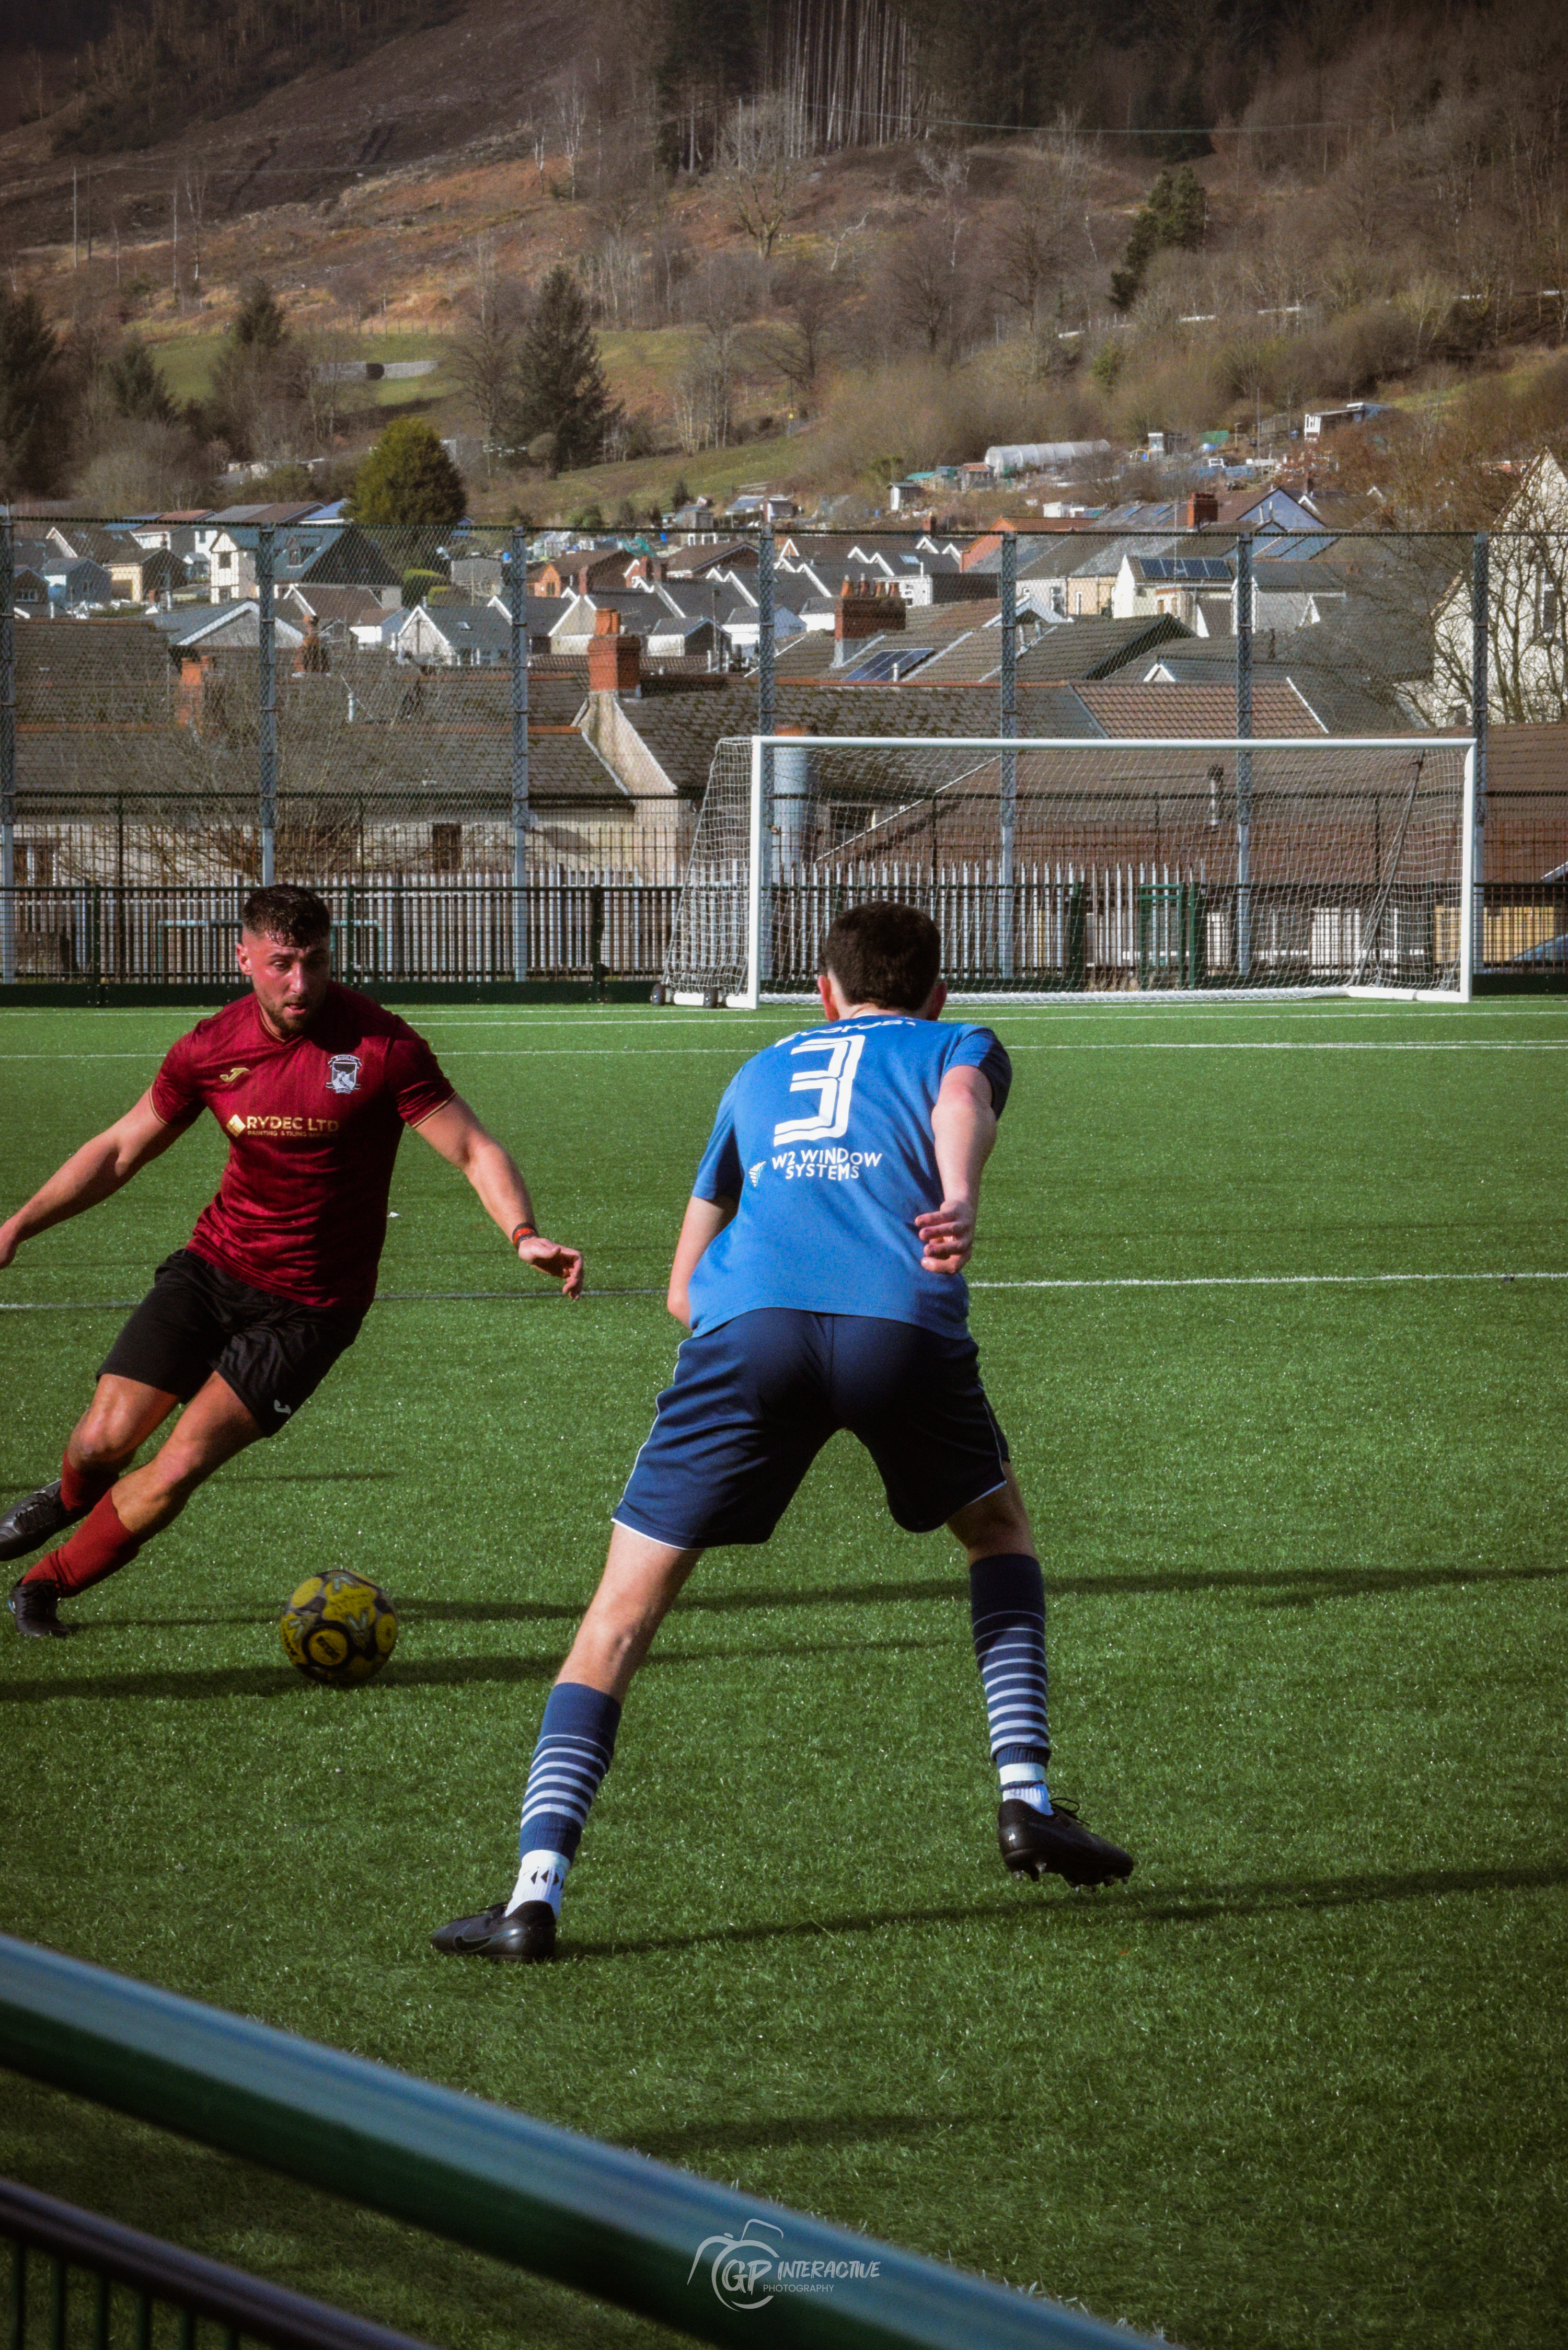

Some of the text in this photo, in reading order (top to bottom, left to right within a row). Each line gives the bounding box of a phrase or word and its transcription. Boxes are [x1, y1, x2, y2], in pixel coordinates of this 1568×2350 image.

[774, 1034, 866, 1147] 3
[247, 1116, 339, 1132] RYDEC LTD
[772, 1148, 882, 1170] W2 WINDOW
[786, 1163, 859, 1181] SYSTEMS
